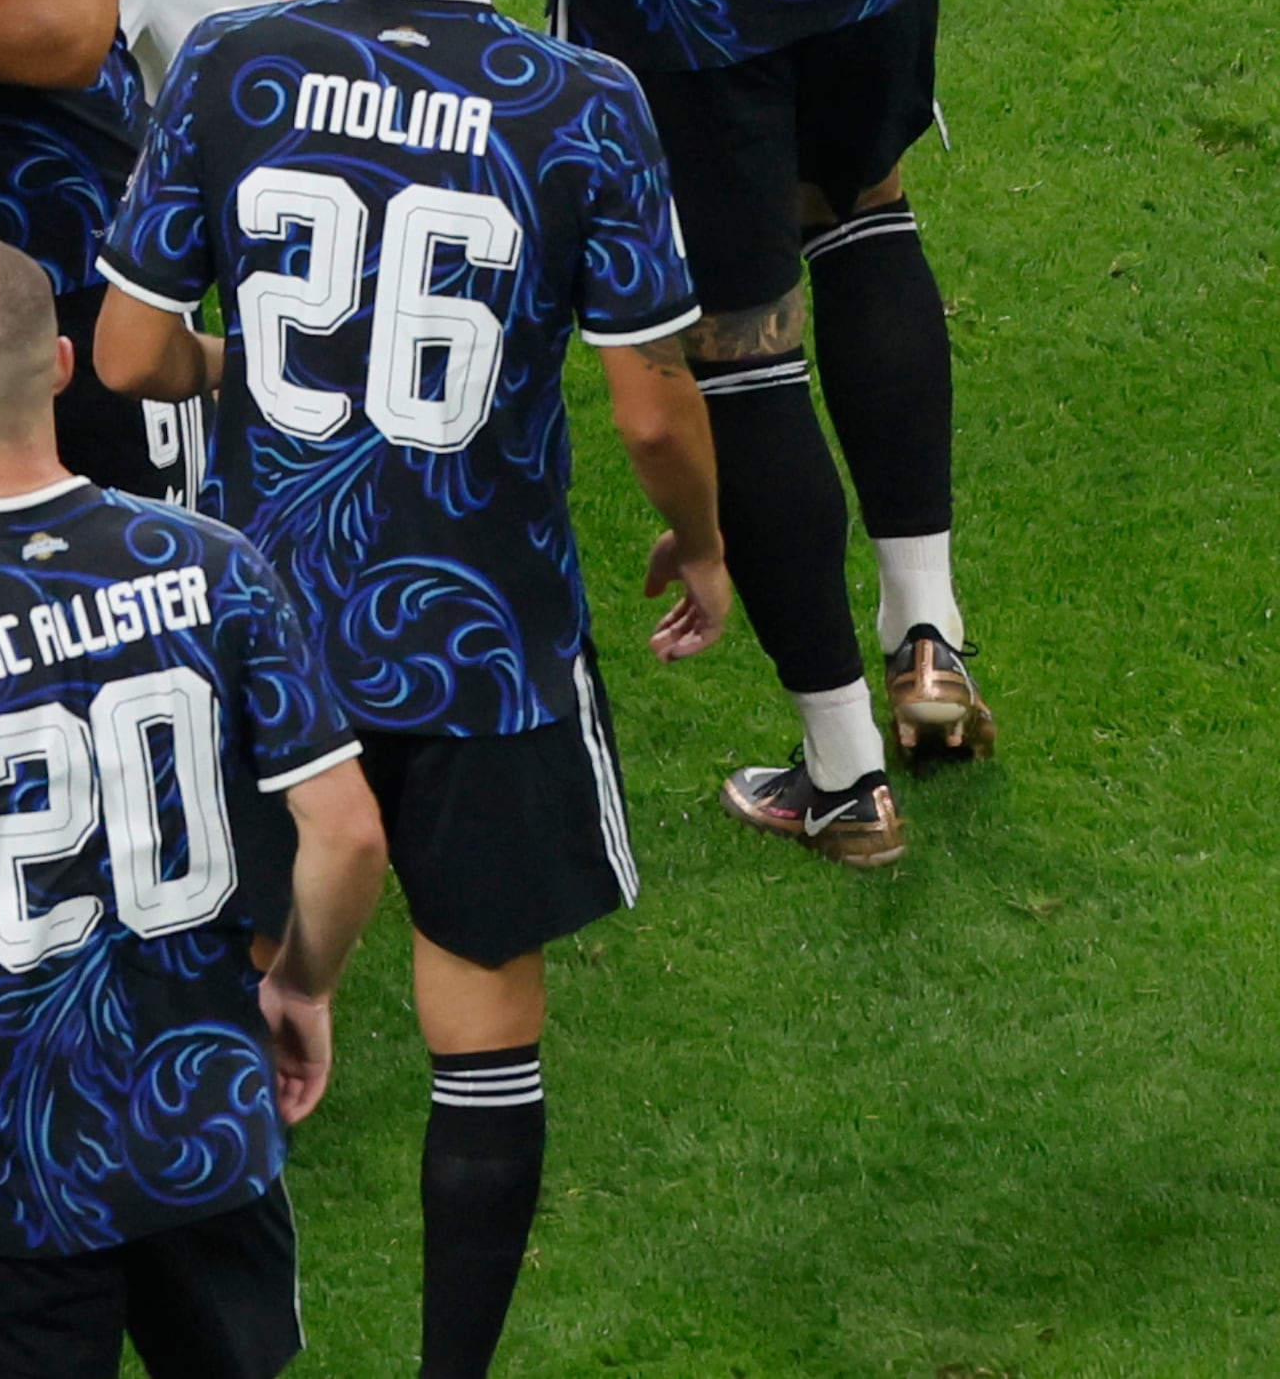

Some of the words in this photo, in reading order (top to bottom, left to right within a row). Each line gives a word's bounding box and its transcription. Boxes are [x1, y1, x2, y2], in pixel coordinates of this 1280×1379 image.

[294, 73, 493, 156] MOLINA
[237, 167, 523, 453] 26
[30, 565, 212, 666] ALLISTER
